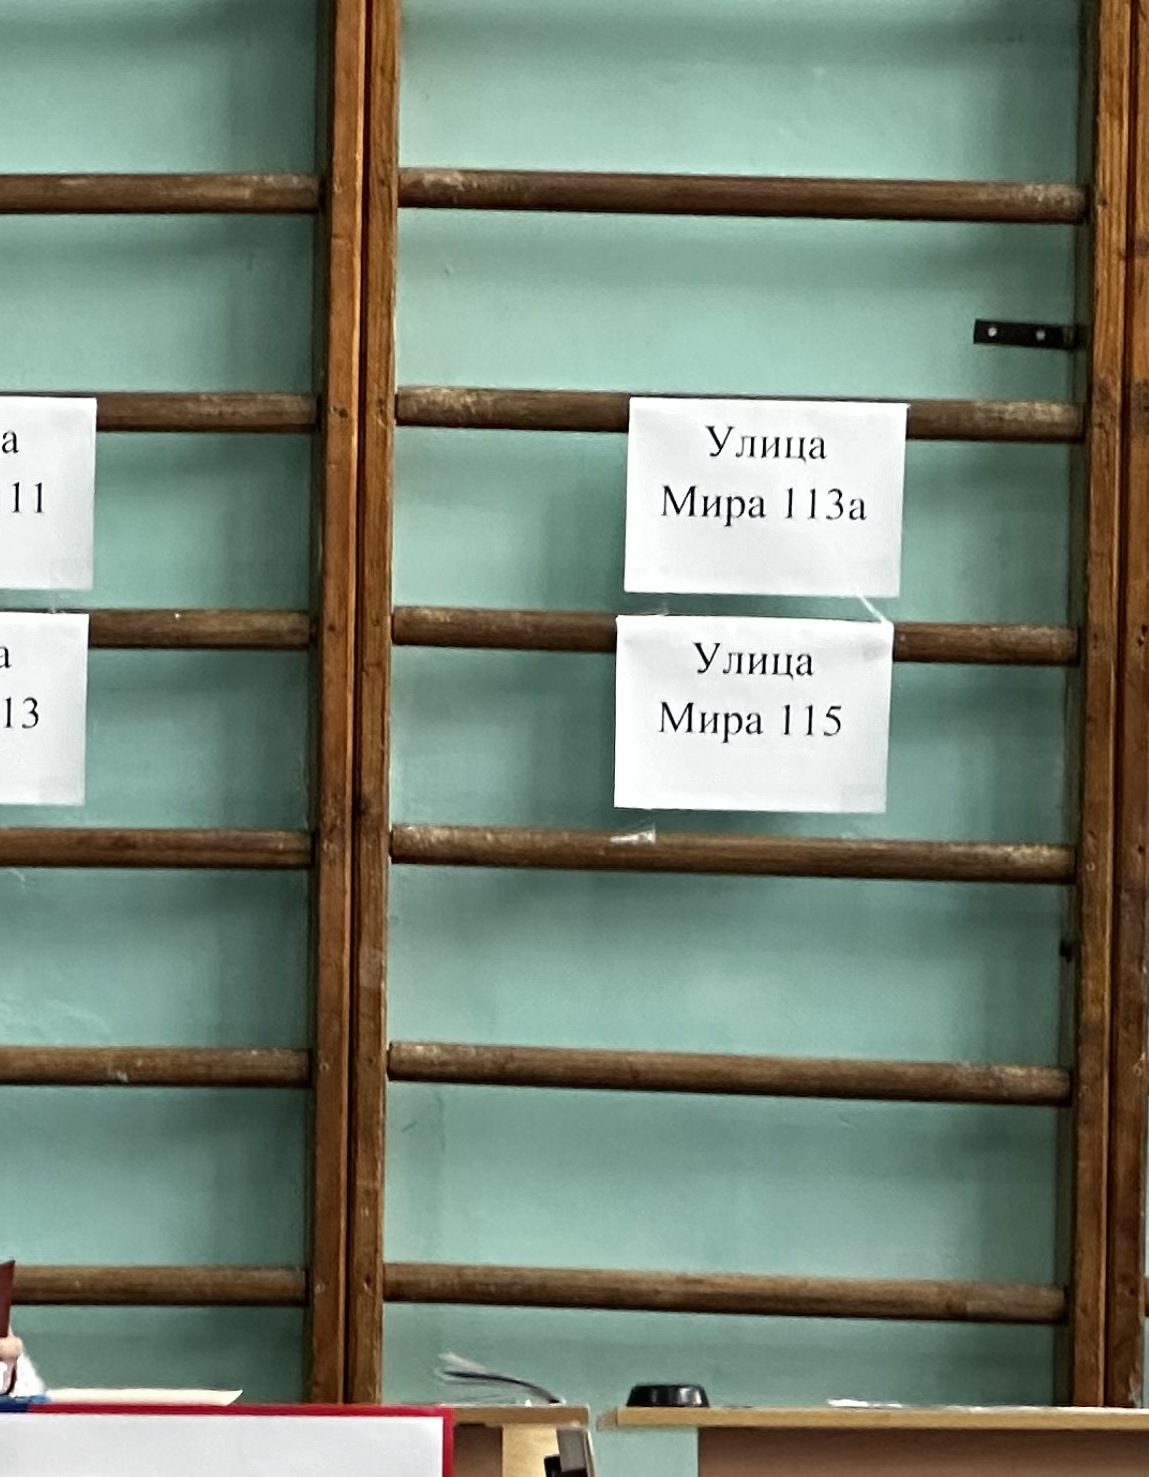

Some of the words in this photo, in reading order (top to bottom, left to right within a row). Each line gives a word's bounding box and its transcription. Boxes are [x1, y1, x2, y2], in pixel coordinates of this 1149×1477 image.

[707, 426, 826, 462] Улица
[661, 486, 766, 526] Мира
[786, 488, 866, 521] 113а
[693, 642, 814, 679] Улица
[659, 702, 764, 743] Мира
[783, 705, 842, 737] 115
